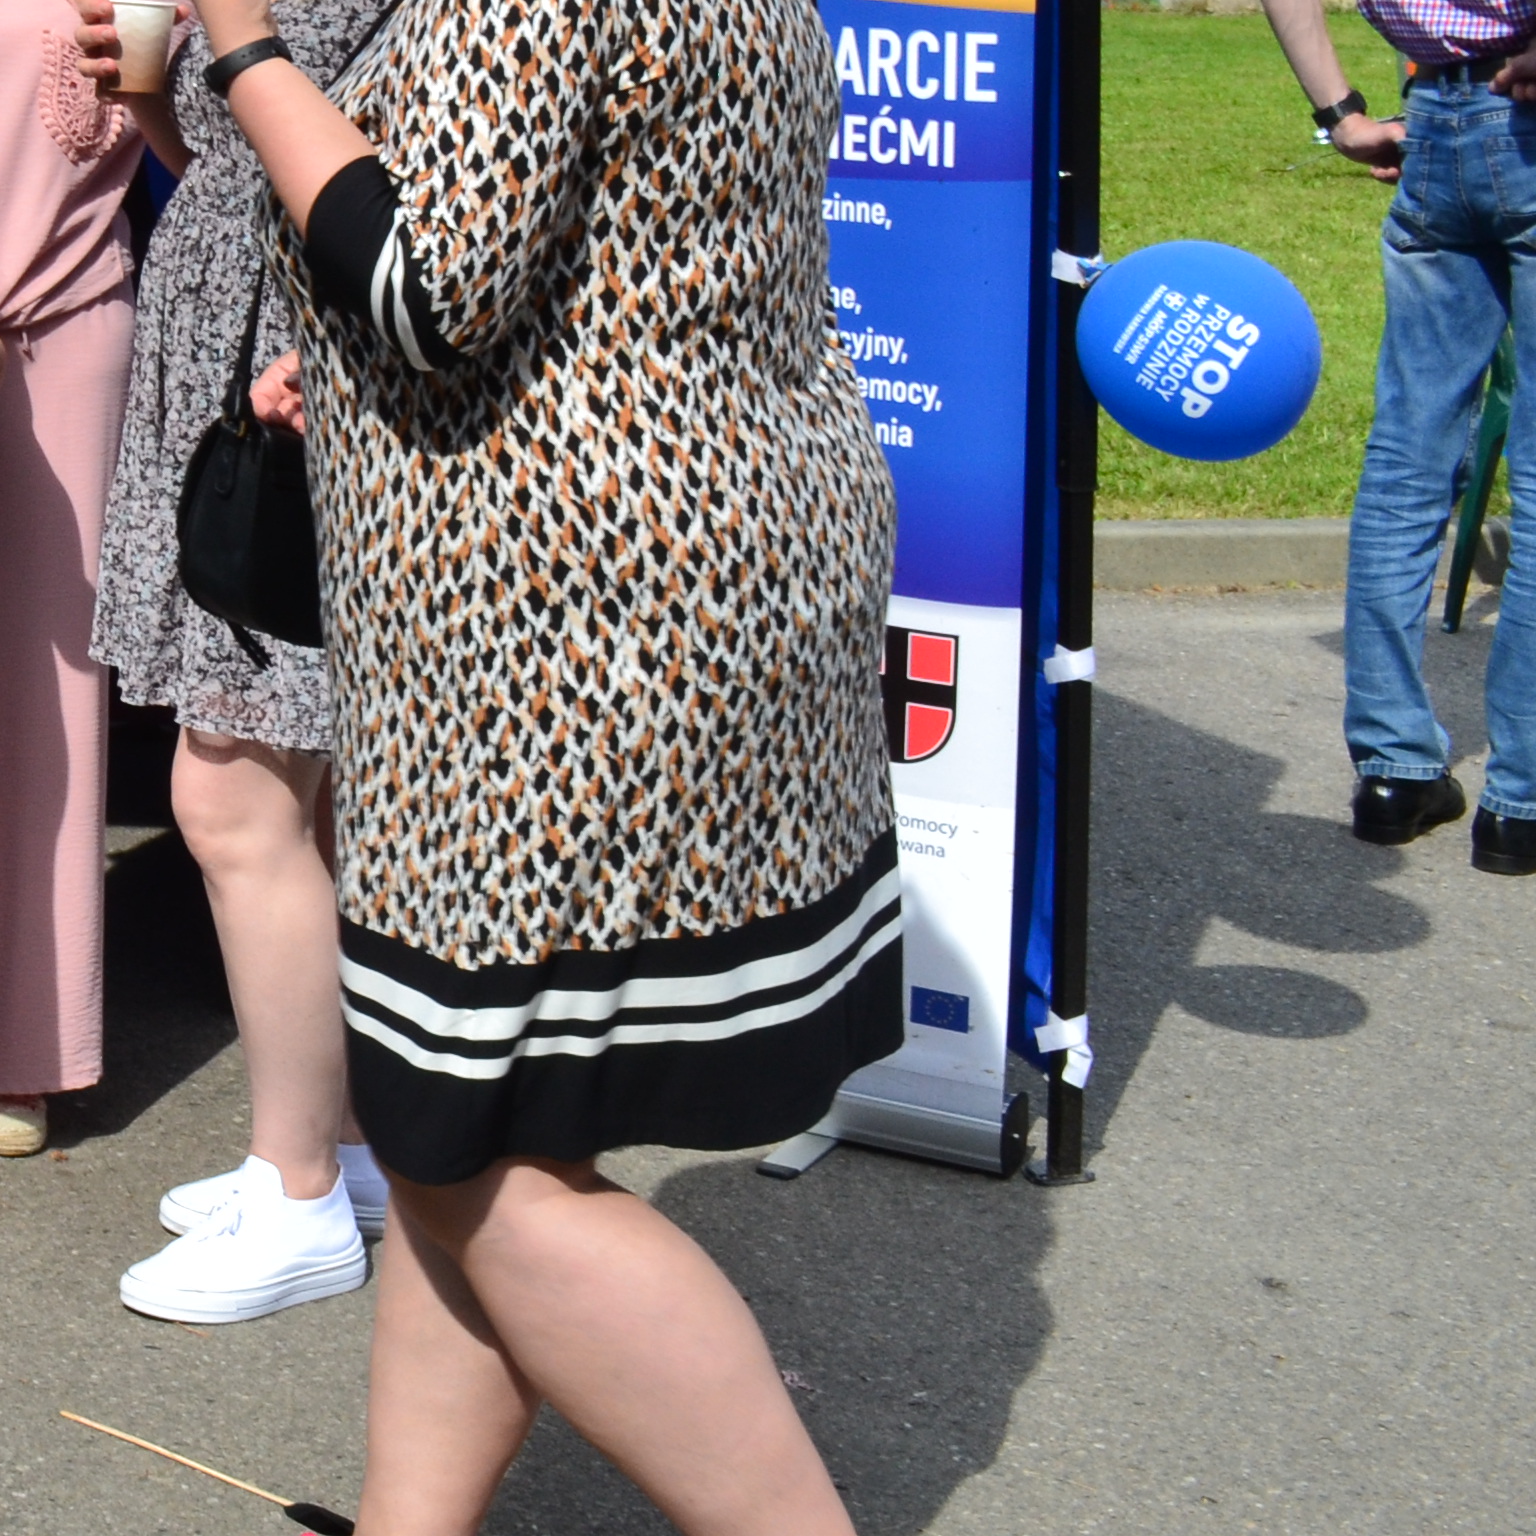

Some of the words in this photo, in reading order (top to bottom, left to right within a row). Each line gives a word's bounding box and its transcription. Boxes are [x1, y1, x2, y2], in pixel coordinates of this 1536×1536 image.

[1135, 306, 1201, 391] RODZINIE
[1155, 303, 1231, 402] PRZEMOCY
[1180, 315, 1261, 419] STOP
